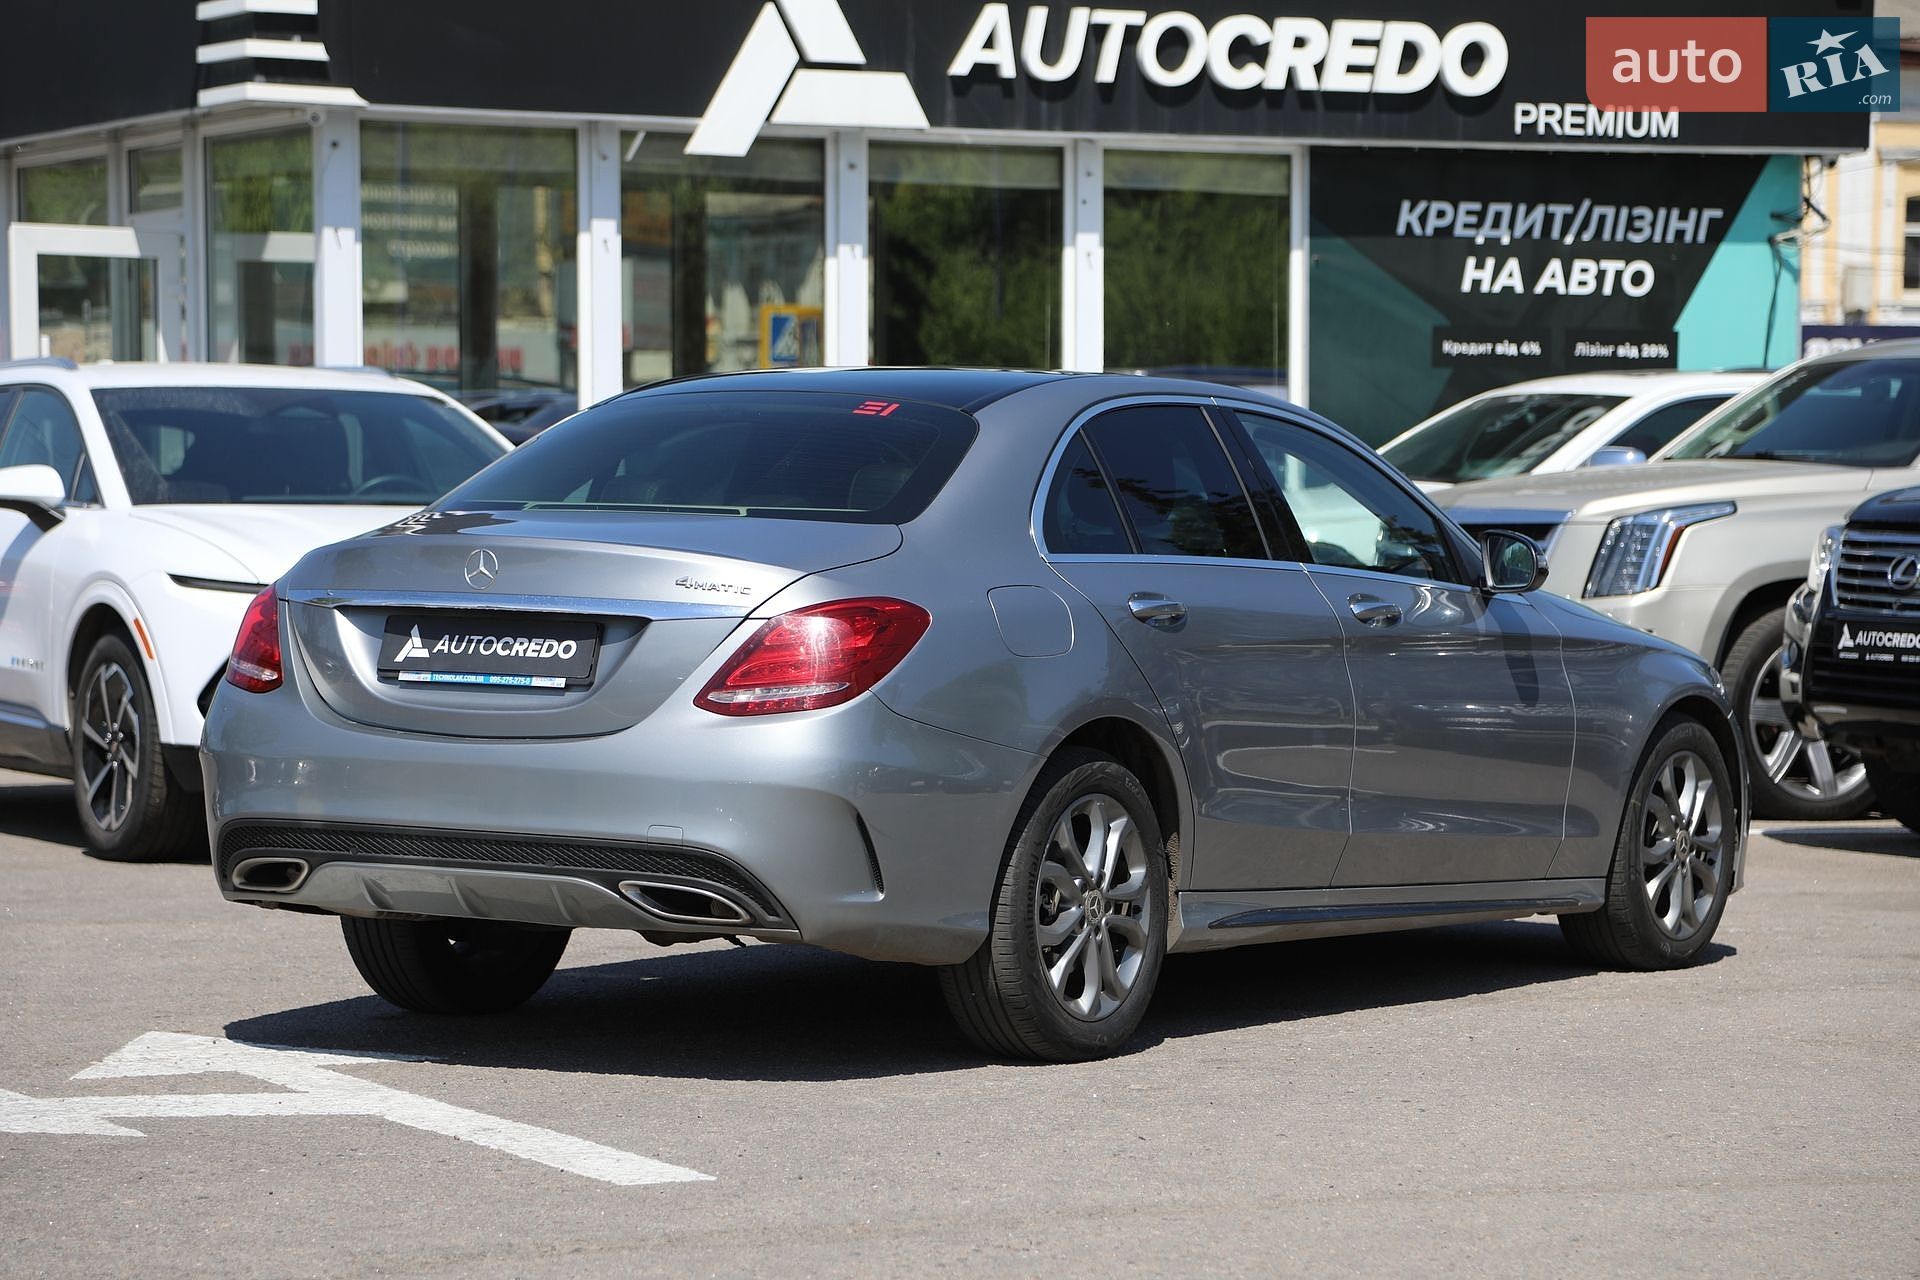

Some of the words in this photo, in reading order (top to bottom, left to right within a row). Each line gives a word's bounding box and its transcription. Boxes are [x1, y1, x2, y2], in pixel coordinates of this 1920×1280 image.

[947, 3, 1508, 97] AUTOCREDO
[1514, 102, 1680, 138] PREMIUM
[1396, 198, 1724, 245] КРЕДИТ/ЛІЗІНГ
[1460, 255, 1525, 294] НА
[1533, 257, 1656, 298] АВТО
[1442, 340, 1493, 356] Кредит
[1495, 340, 1518, 357] від
[1574, 341, 1615, 357] Лізінг
[1617, 342, 1639, 359] від
[675, 576, 752, 595] 4MATIC
[432, 634, 577, 660] AUTOCREDO
